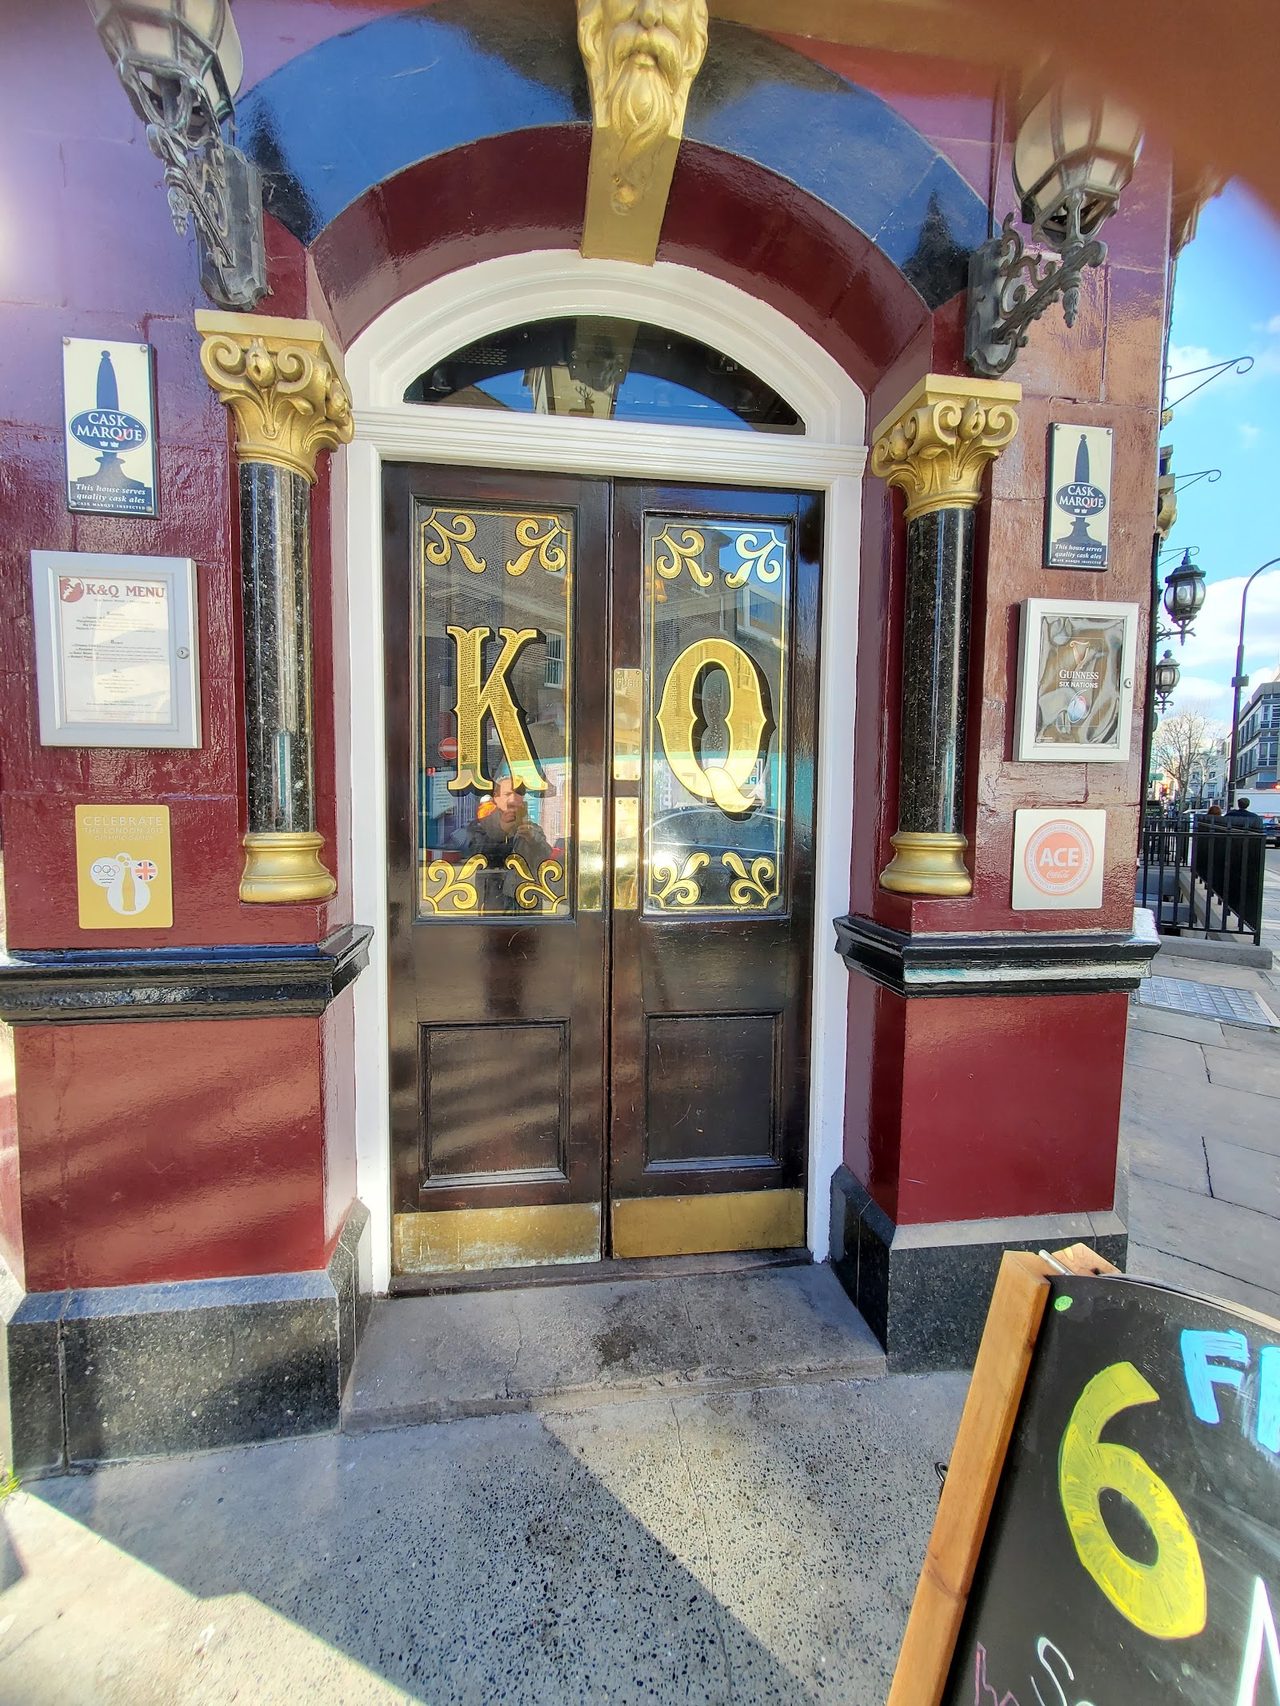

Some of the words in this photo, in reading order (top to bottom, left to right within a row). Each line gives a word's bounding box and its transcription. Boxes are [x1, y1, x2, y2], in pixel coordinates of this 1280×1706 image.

[88, 413, 128, 427] CASK
[77, 425, 142, 441] MARQUE
[76, 483, 94, 492] This
[96, 484, 120, 493] house
[121, 487, 146, 495] serves
[1067, 485, 1095, 497] CASK
[76, 493, 107, 503] quality
[109, 495, 127, 503] cask
[129, 496, 145, 504] ales
[1059, 495, 1104, 508] MARQUE
[86, 583, 119, 598] K&Q
[126, 585, 165, 598] MENU
[1058, 669, 1099, 680] GUINNESS
[1071, 681, 1099, 689] NATIONS
[446, 625, 549, 794] K
[655, 637, 774, 818] Q
[83, 816, 163, 826] CELEBRATE
[1039, 847, 1080, 867] ACE
[1058, 1361, 1207, 1640] 6
